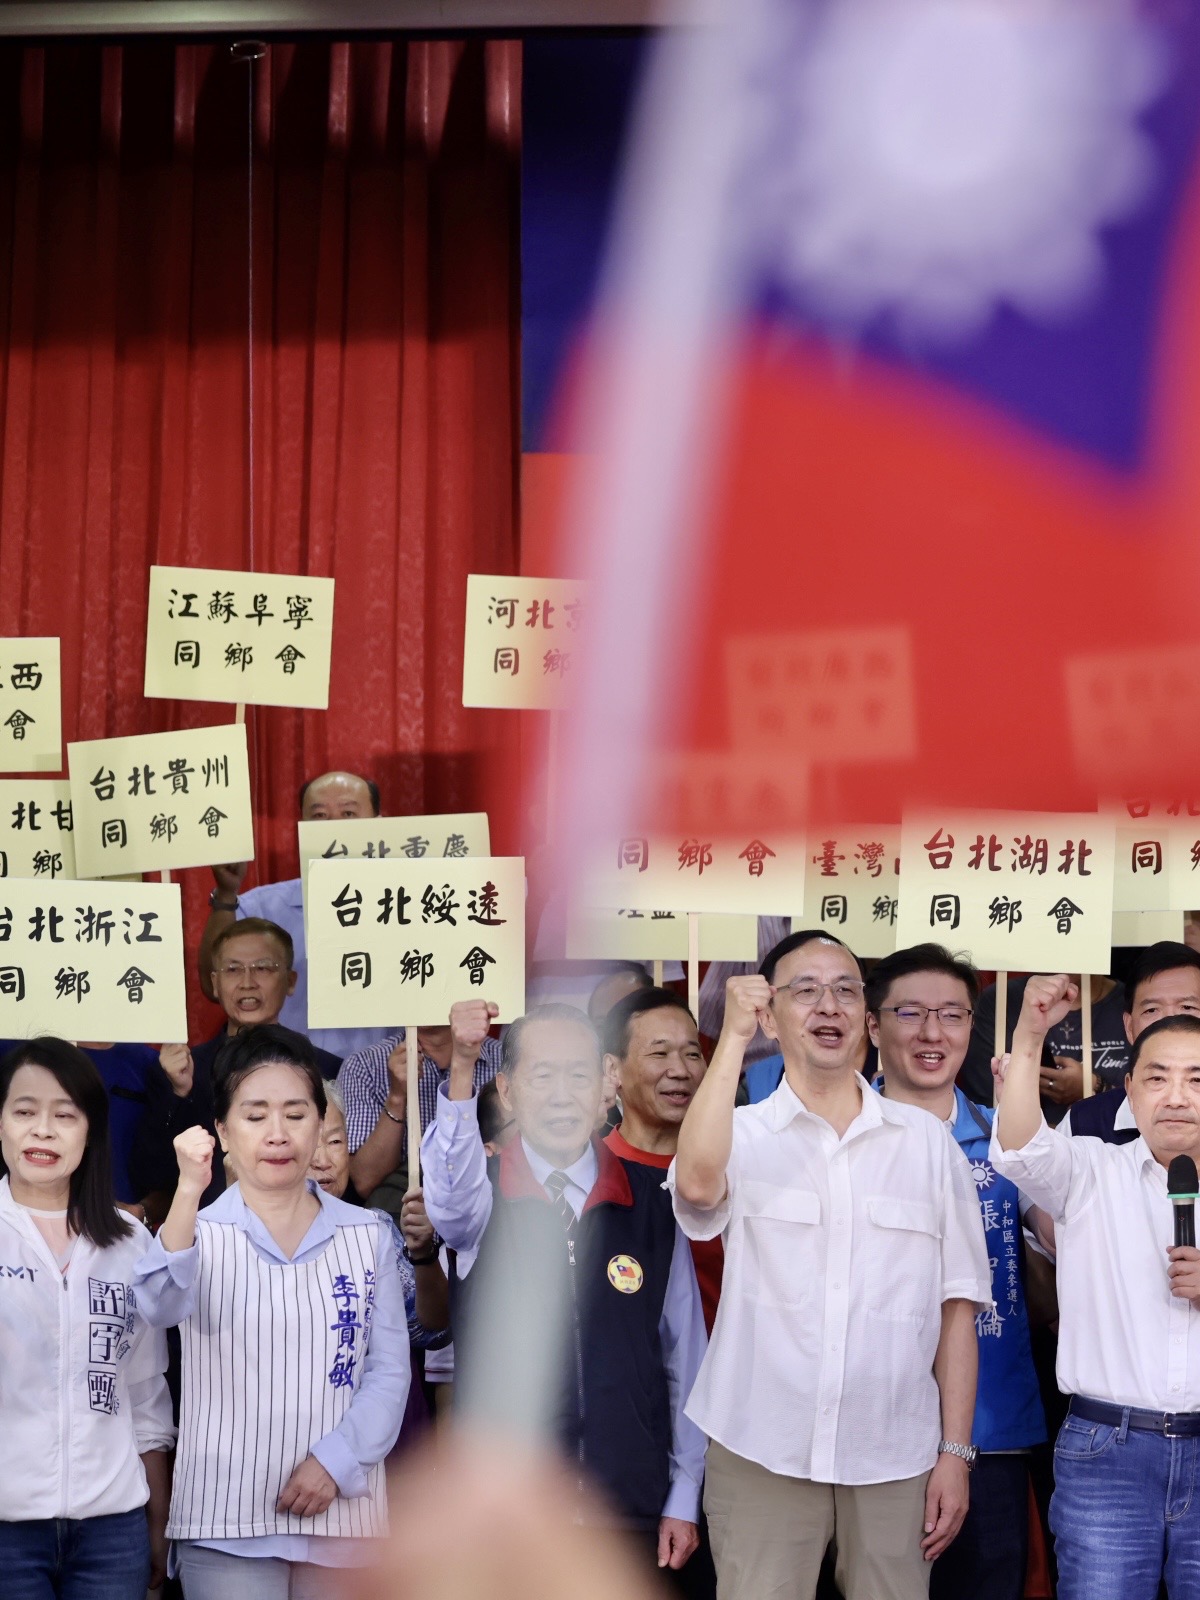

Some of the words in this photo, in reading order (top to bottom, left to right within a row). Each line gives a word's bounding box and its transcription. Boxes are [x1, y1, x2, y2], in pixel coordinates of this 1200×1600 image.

[168, 587, 314, 630] 江蘇阜寧
[0, 662, 43, 691] 西
[174, 640, 306, 675] 同鄉會
[90, 754, 229, 801] 台北貴州
[102, 806, 228, 849] 同鄉會
[0, 850, 63, 879] 鄉
[617, 838, 776, 877] 同鄉會
[812, 840, 900, 878] 臺灣
[923, 827, 1093, 877] 台北湖北
[331, 881, 507, 928] 台北綏遠
[929, 894, 1084, 936] 同鄉會
[0, 966, 156, 1005] 同鄉會
[341, 946, 497, 989] 同鄉會
[328, 1274, 362, 1390] 李貴敏
